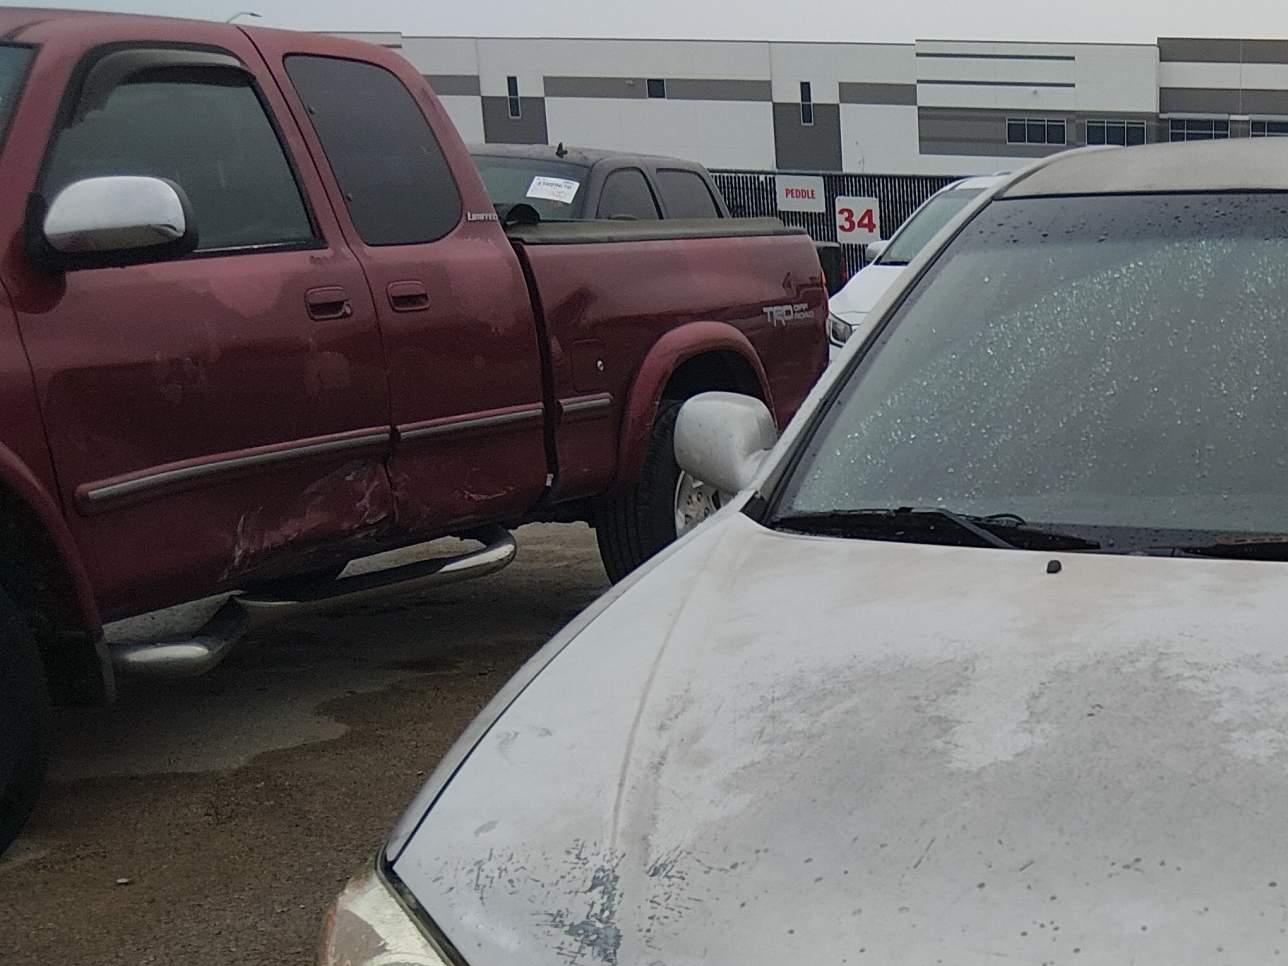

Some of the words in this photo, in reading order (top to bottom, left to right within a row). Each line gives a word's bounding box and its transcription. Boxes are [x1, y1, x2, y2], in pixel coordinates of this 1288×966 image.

[785, 188, 816, 200] PEDDLE
[838, 208, 877, 233] 34
[762, 304, 794, 327] TRD
